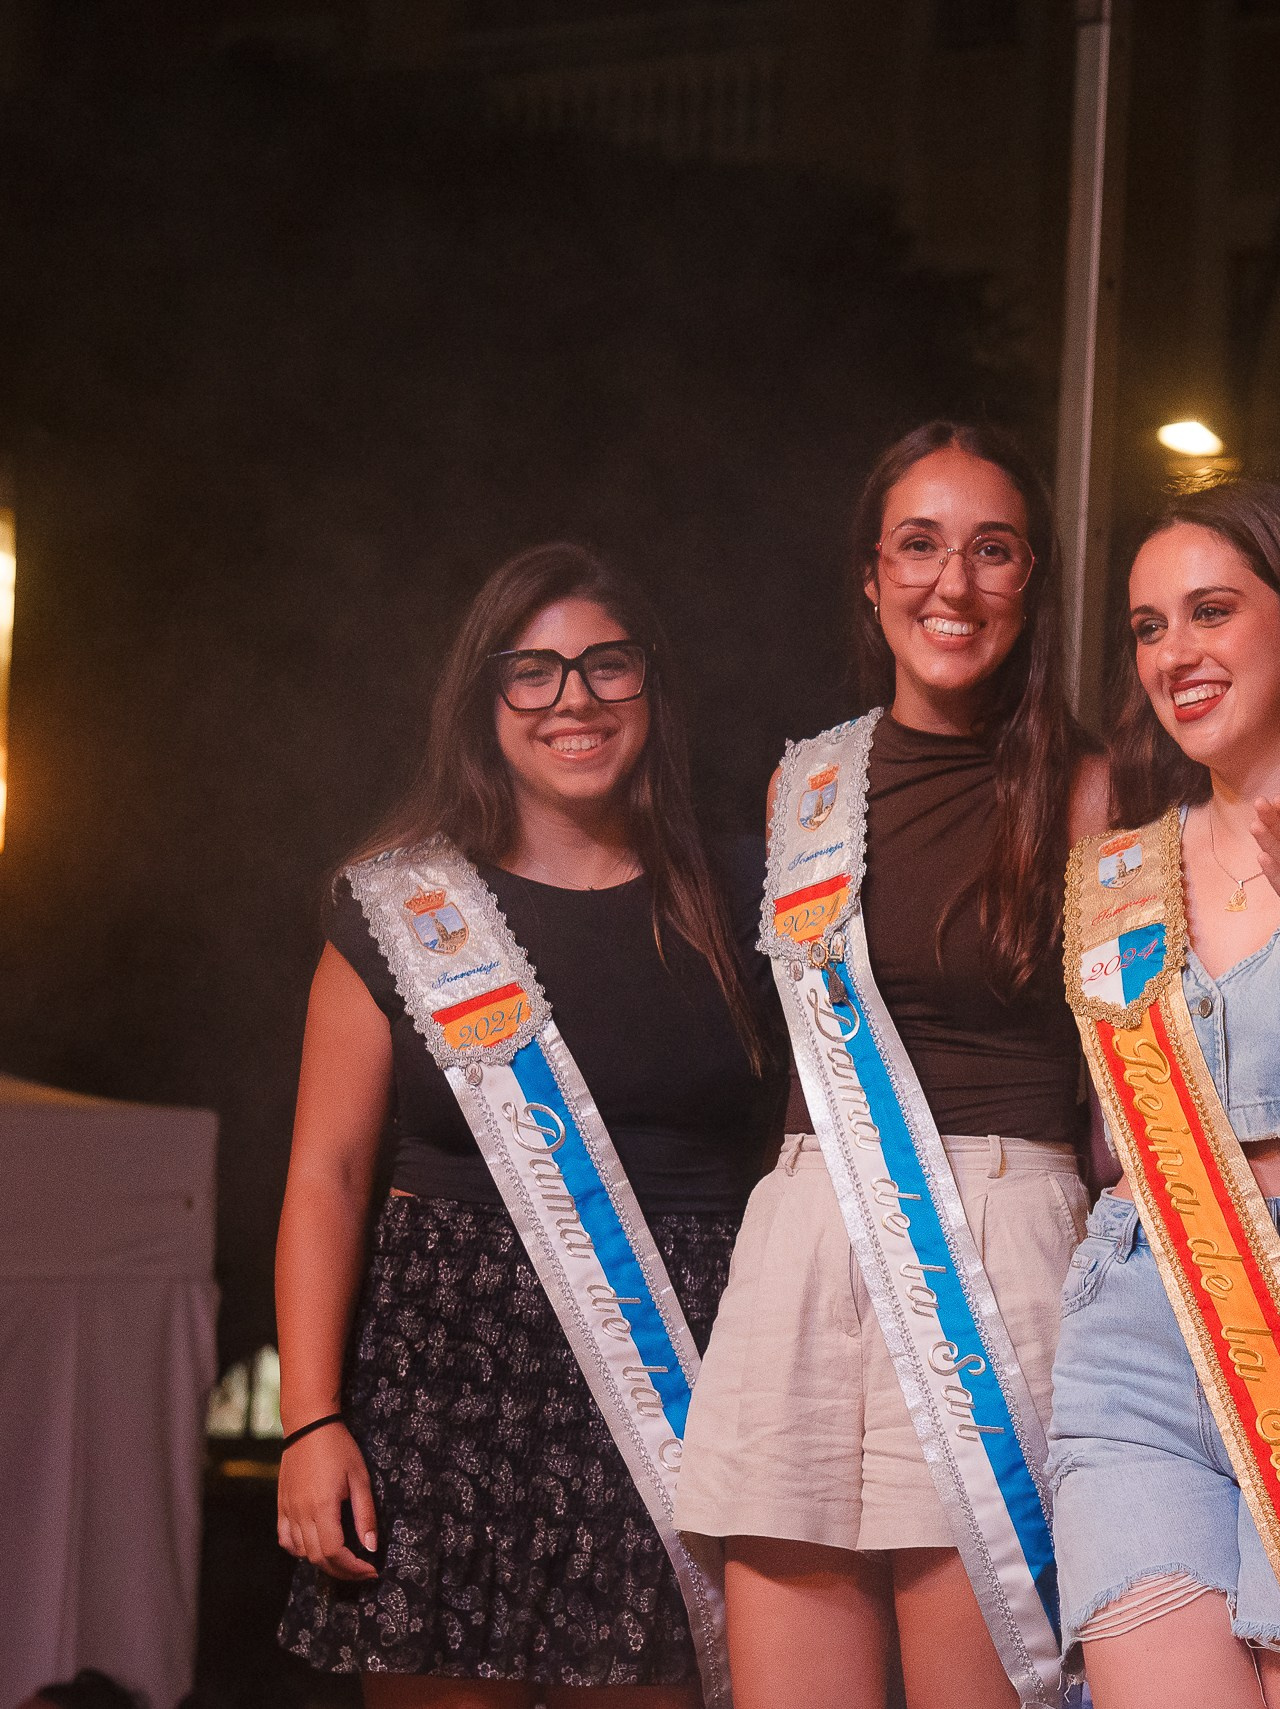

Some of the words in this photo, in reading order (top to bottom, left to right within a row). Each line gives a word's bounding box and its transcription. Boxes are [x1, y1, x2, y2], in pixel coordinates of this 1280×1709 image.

[782, 892, 841, 937] 2024
[1084, 938, 1159, 984] 2024
[457, 999, 524, 1050] 2024
[501, 1100, 596, 1259] Dama
[586, 1284, 641, 1342] de
[622, 1365, 669, 1419] la
[807, 987, 881, 1152] Dama
[870, 1176, 921, 1239] de
[900, 1262, 947, 1318] la
[927, 1340, 1005, 1441] Sal
[1111, 1034, 1201, 1218] Reina
[1187, 1237, 1244, 1301] de
[1221, 1326, 1273, 1383] la
